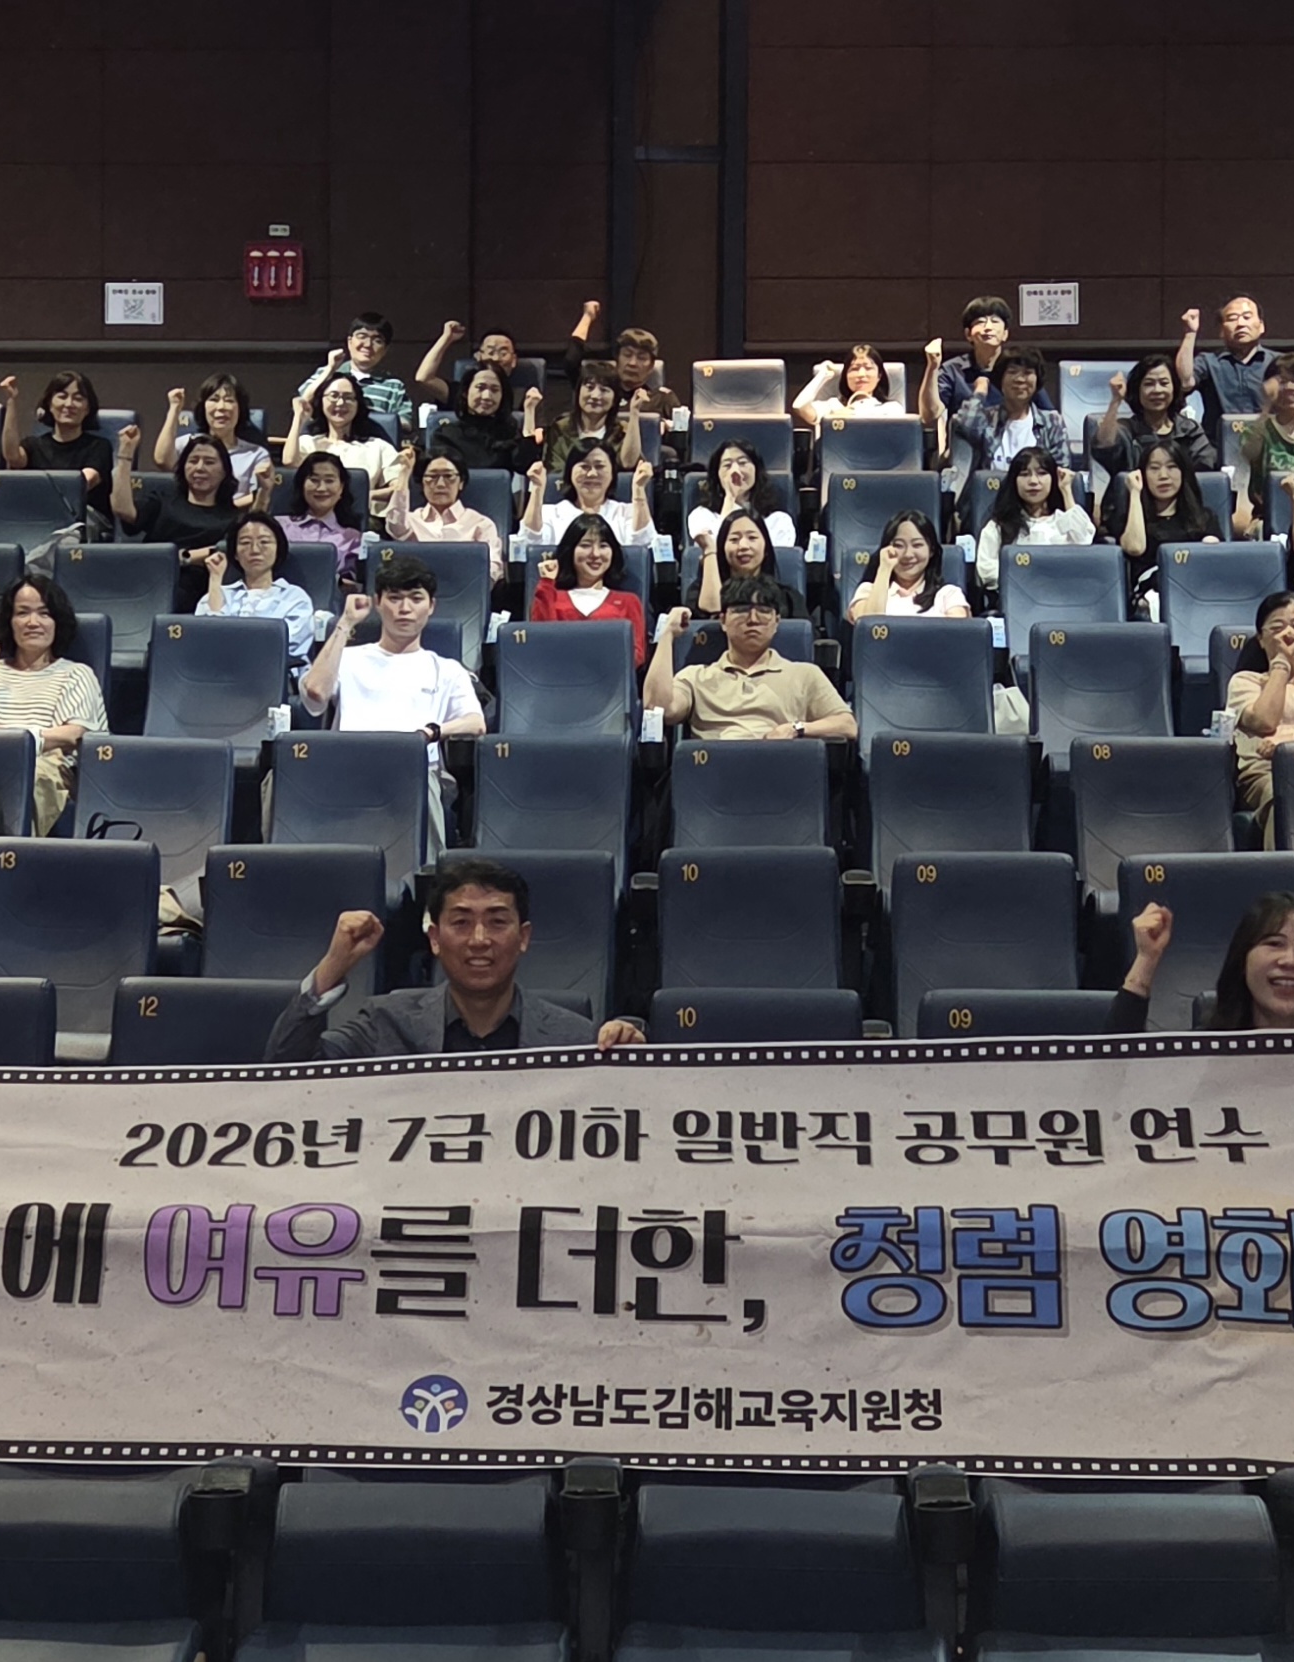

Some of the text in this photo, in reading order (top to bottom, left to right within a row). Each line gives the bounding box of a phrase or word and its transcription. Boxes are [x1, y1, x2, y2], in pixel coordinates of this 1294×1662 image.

[702, 420, 714, 431] 10
[987, 478, 1000, 490] 08
[69, 548, 83, 560] 14
[380, 548, 394, 561] 12
[855, 551, 870, 565] 09
[1016, 553, 1030, 566] 08
[1174, 550, 1189, 564] 07
[167, 624, 182, 639] 13
[513, 628, 527, 644] 11
[694, 631, 708, 646] 10
[871, 625, 888, 640] 09
[1049, 630, 1065, 645] 08
[1230, 634, 1245, 649] 07
[96, 746, 113, 761] 13
[292, 743, 308, 758] 12
[495, 742, 510, 758] 11
[892, 740, 910, 756] 09
[1093, 744, 1111, 760] 08
[692, 749, 708, 765] 10
[227, 860, 246, 879] 12
[682, 863, 699, 881] 10
[916, 865, 937, 883] 09
[1144, 864, 1165, 883] 08
[138, 996, 158, 1016] 12
[676, 1007, 696, 1027] 10
[949, 1008, 972, 1028] 09
[118, 1106, 1270, 1168] 2026년 7급 이하 일반직 공무원 연수
[142, 1202, 477, 1318] 여유를
[516, 1205, 767, 1333] 더한,
[829, 1203, 1064, 1330] 청렴
[485, 1383, 944, 1432] 경상남도김해교육지원청
